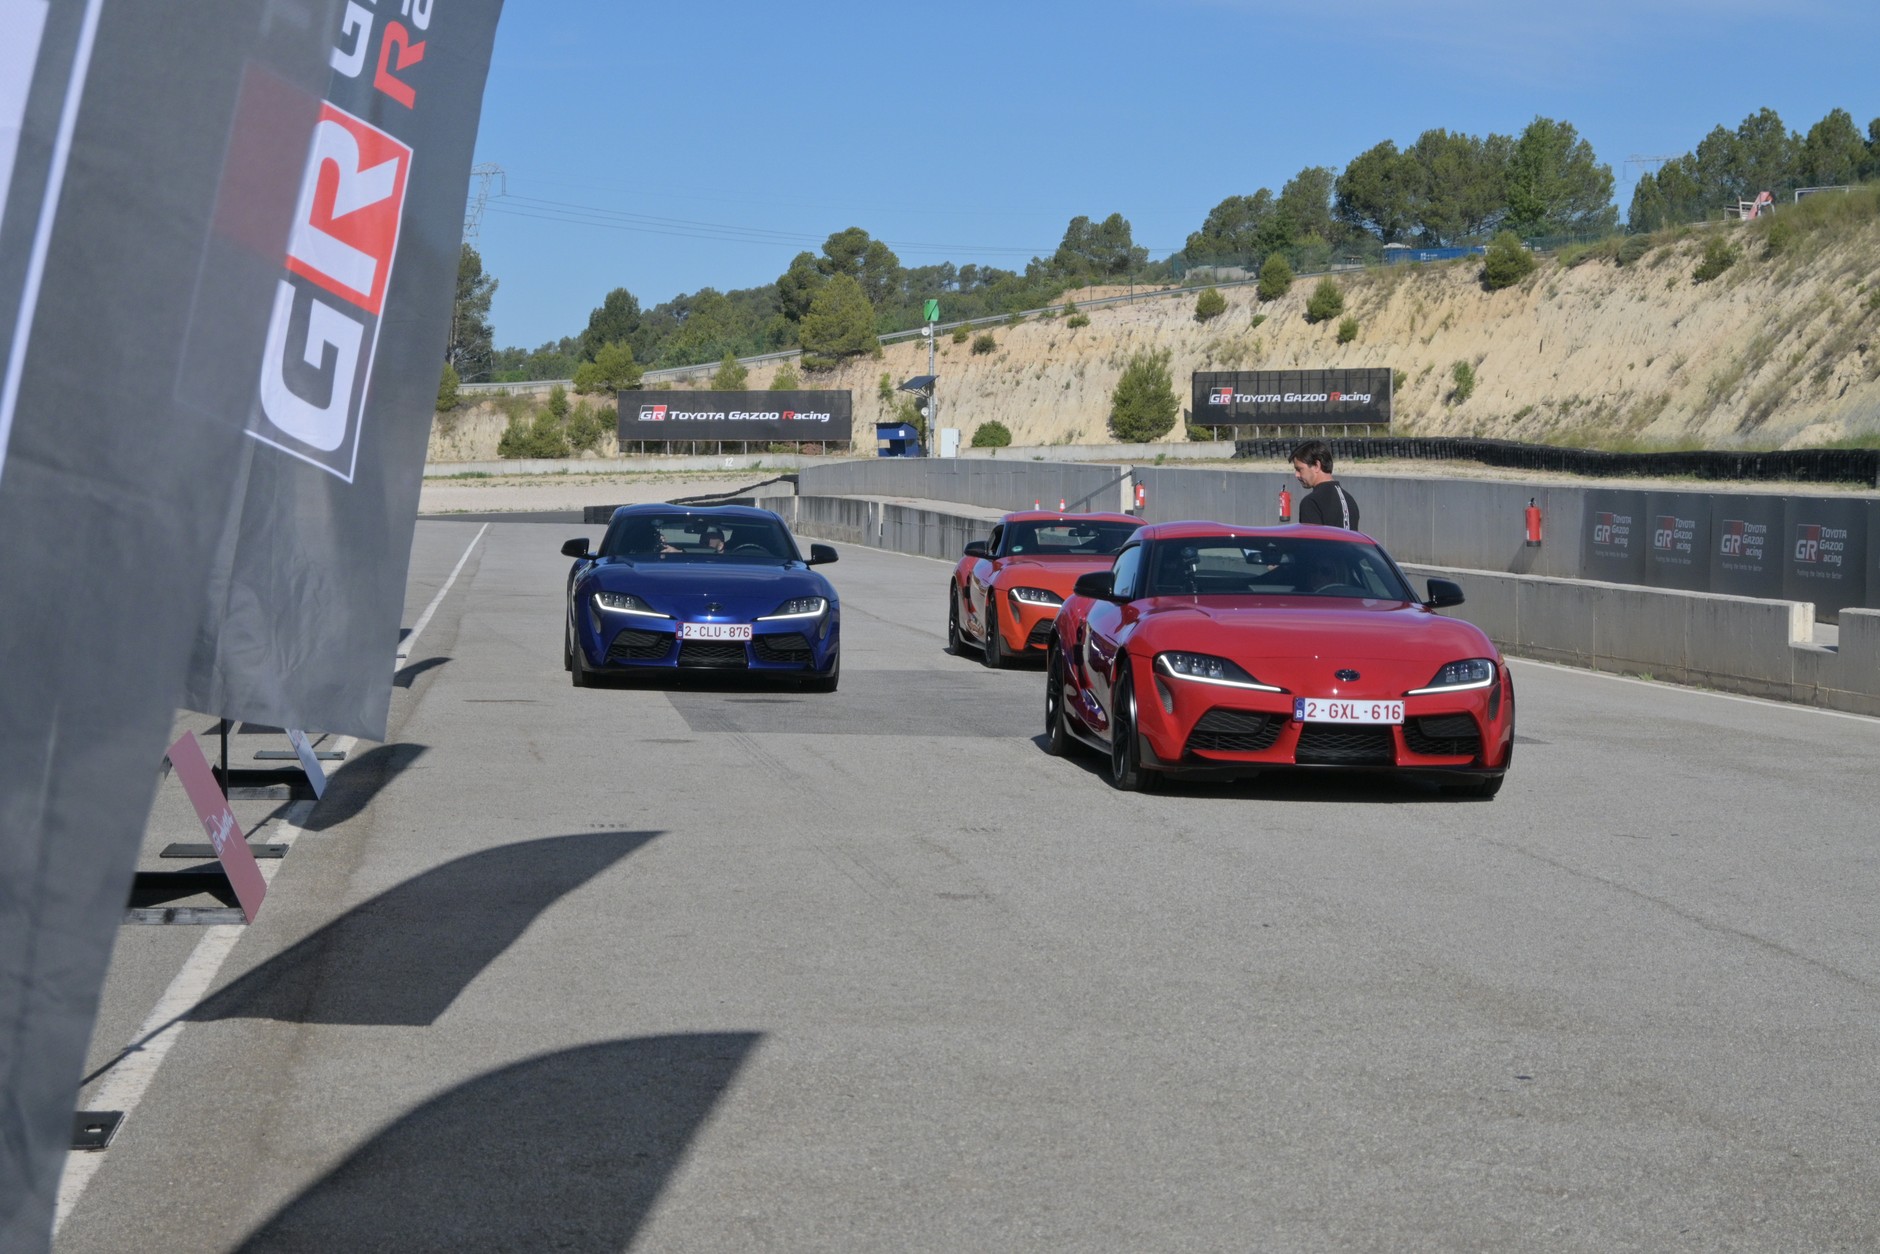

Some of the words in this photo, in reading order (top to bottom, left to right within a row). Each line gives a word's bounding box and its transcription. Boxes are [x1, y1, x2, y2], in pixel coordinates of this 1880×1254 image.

[261, 119, 399, 452] GR
[1210, 393, 1231, 403] GR
[1234, 393, 1281, 403] TOYOTA
[1283, 392, 1328, 402] GAZOO
[1329, 391, 1371, 404] Racing
[640, 411, 665, 420] GR
[669, 411, 725, 420] TOYOTA
[728, 411, 779, 420] GAZOO
[782, 410, 830, 422] Racing
[1613, 514, 1632, 524] TOYOTA
[1675, 518, 1695, 529] TOYOTA
[1594, 525, 1610, 542] GR
[1744, 522, 1767, 533] TOYOTA
[1821, 526, 1847, 539] TOYOTA
[1655, 529, 1672, 547] GR
[1674, 529, 1693, 540] GAZOO
[1742, 534, 1764, 545] GAZOO
[1611, 535, 1628, 548] acing
[1672, 540, 1691, 553] acing
[1721, 534, 1741, 553] GR
[1819, 539, 1844, 551] GAZOO
[1796, 539, 1817, 560] GR
[685, 625, 750, 638] 2-CLU-876
[1296, 710, 1303, 718] B
[1307, 702, 1401, 720] 2-GXL-616
